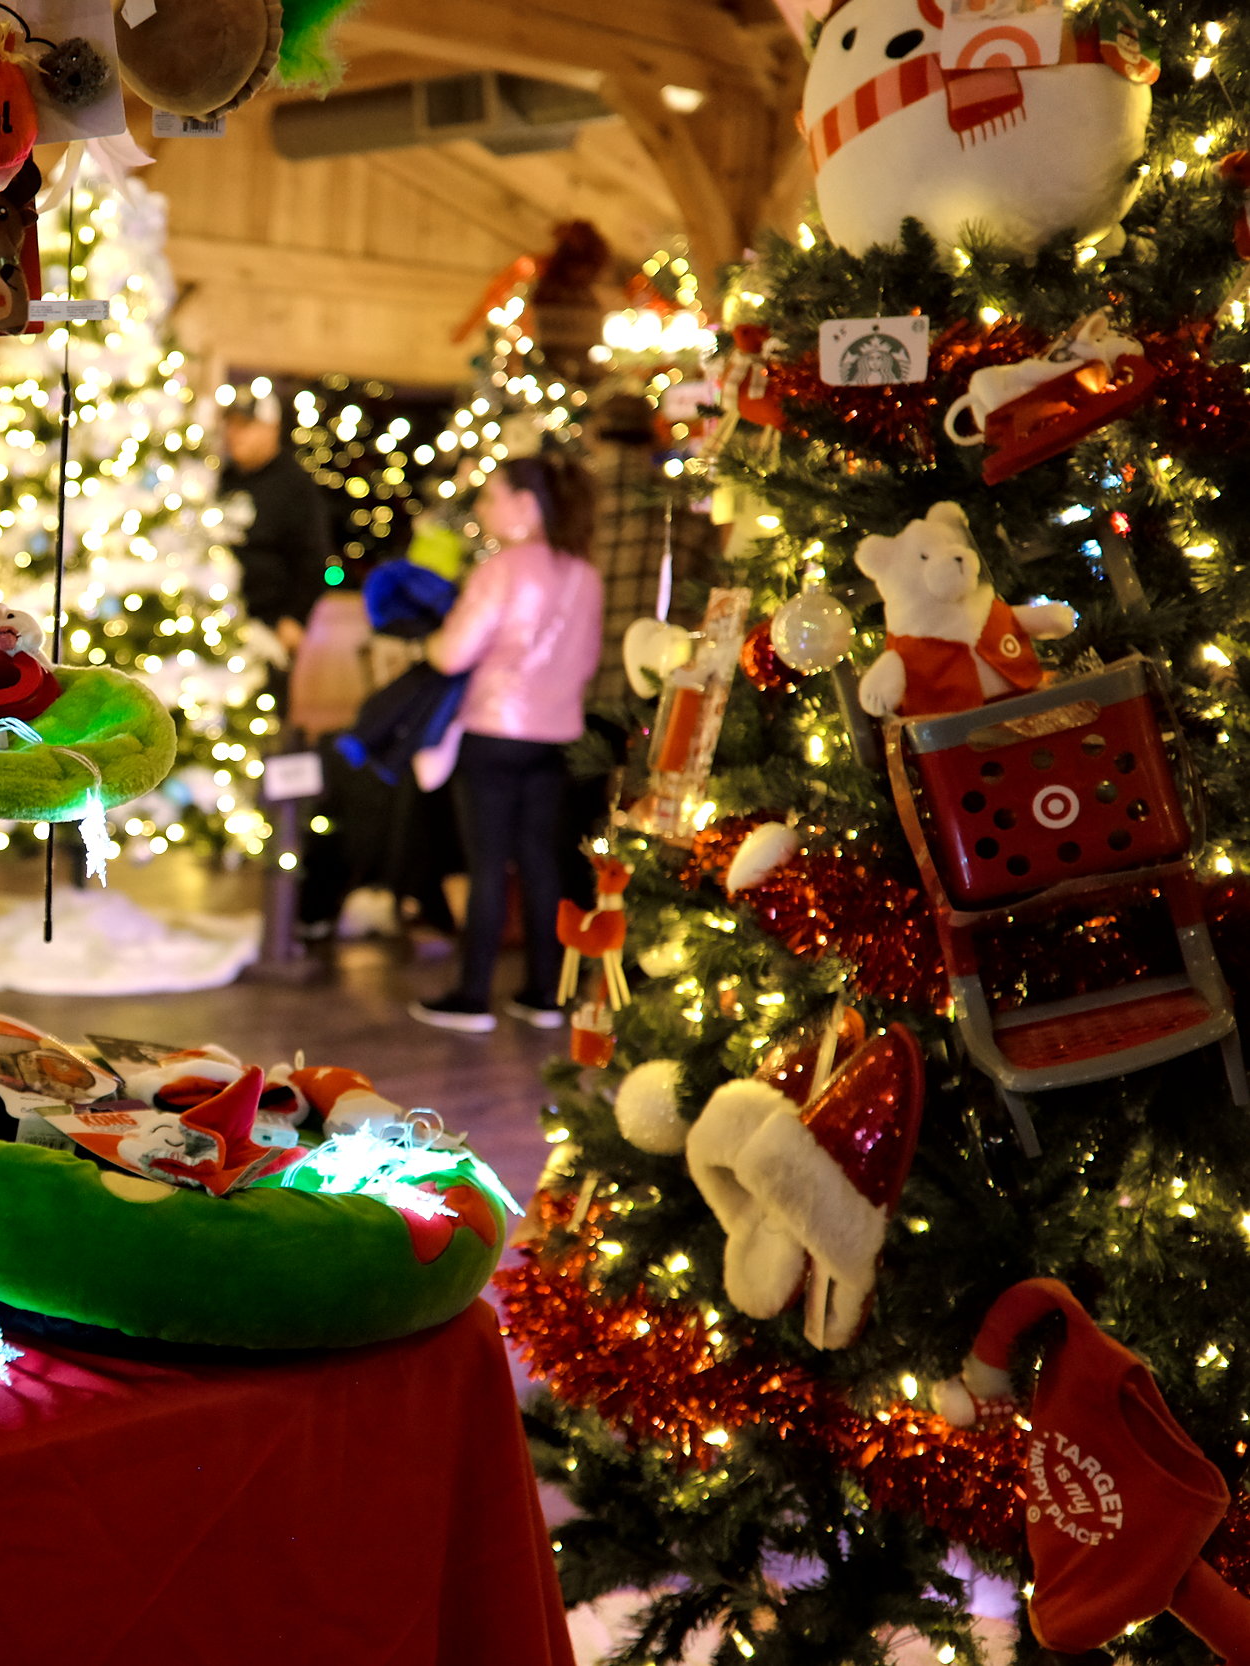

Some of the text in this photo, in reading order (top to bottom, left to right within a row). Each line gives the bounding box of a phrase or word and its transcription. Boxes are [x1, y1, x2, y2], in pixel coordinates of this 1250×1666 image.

[76, 1112, 139, 1128] KONG
[1029, 1440, 1103, 1546] HAPPY PLACE
[1054, 1432, 1124, 1530] TARGET
[1064, 1482, 1095, 1515] my
